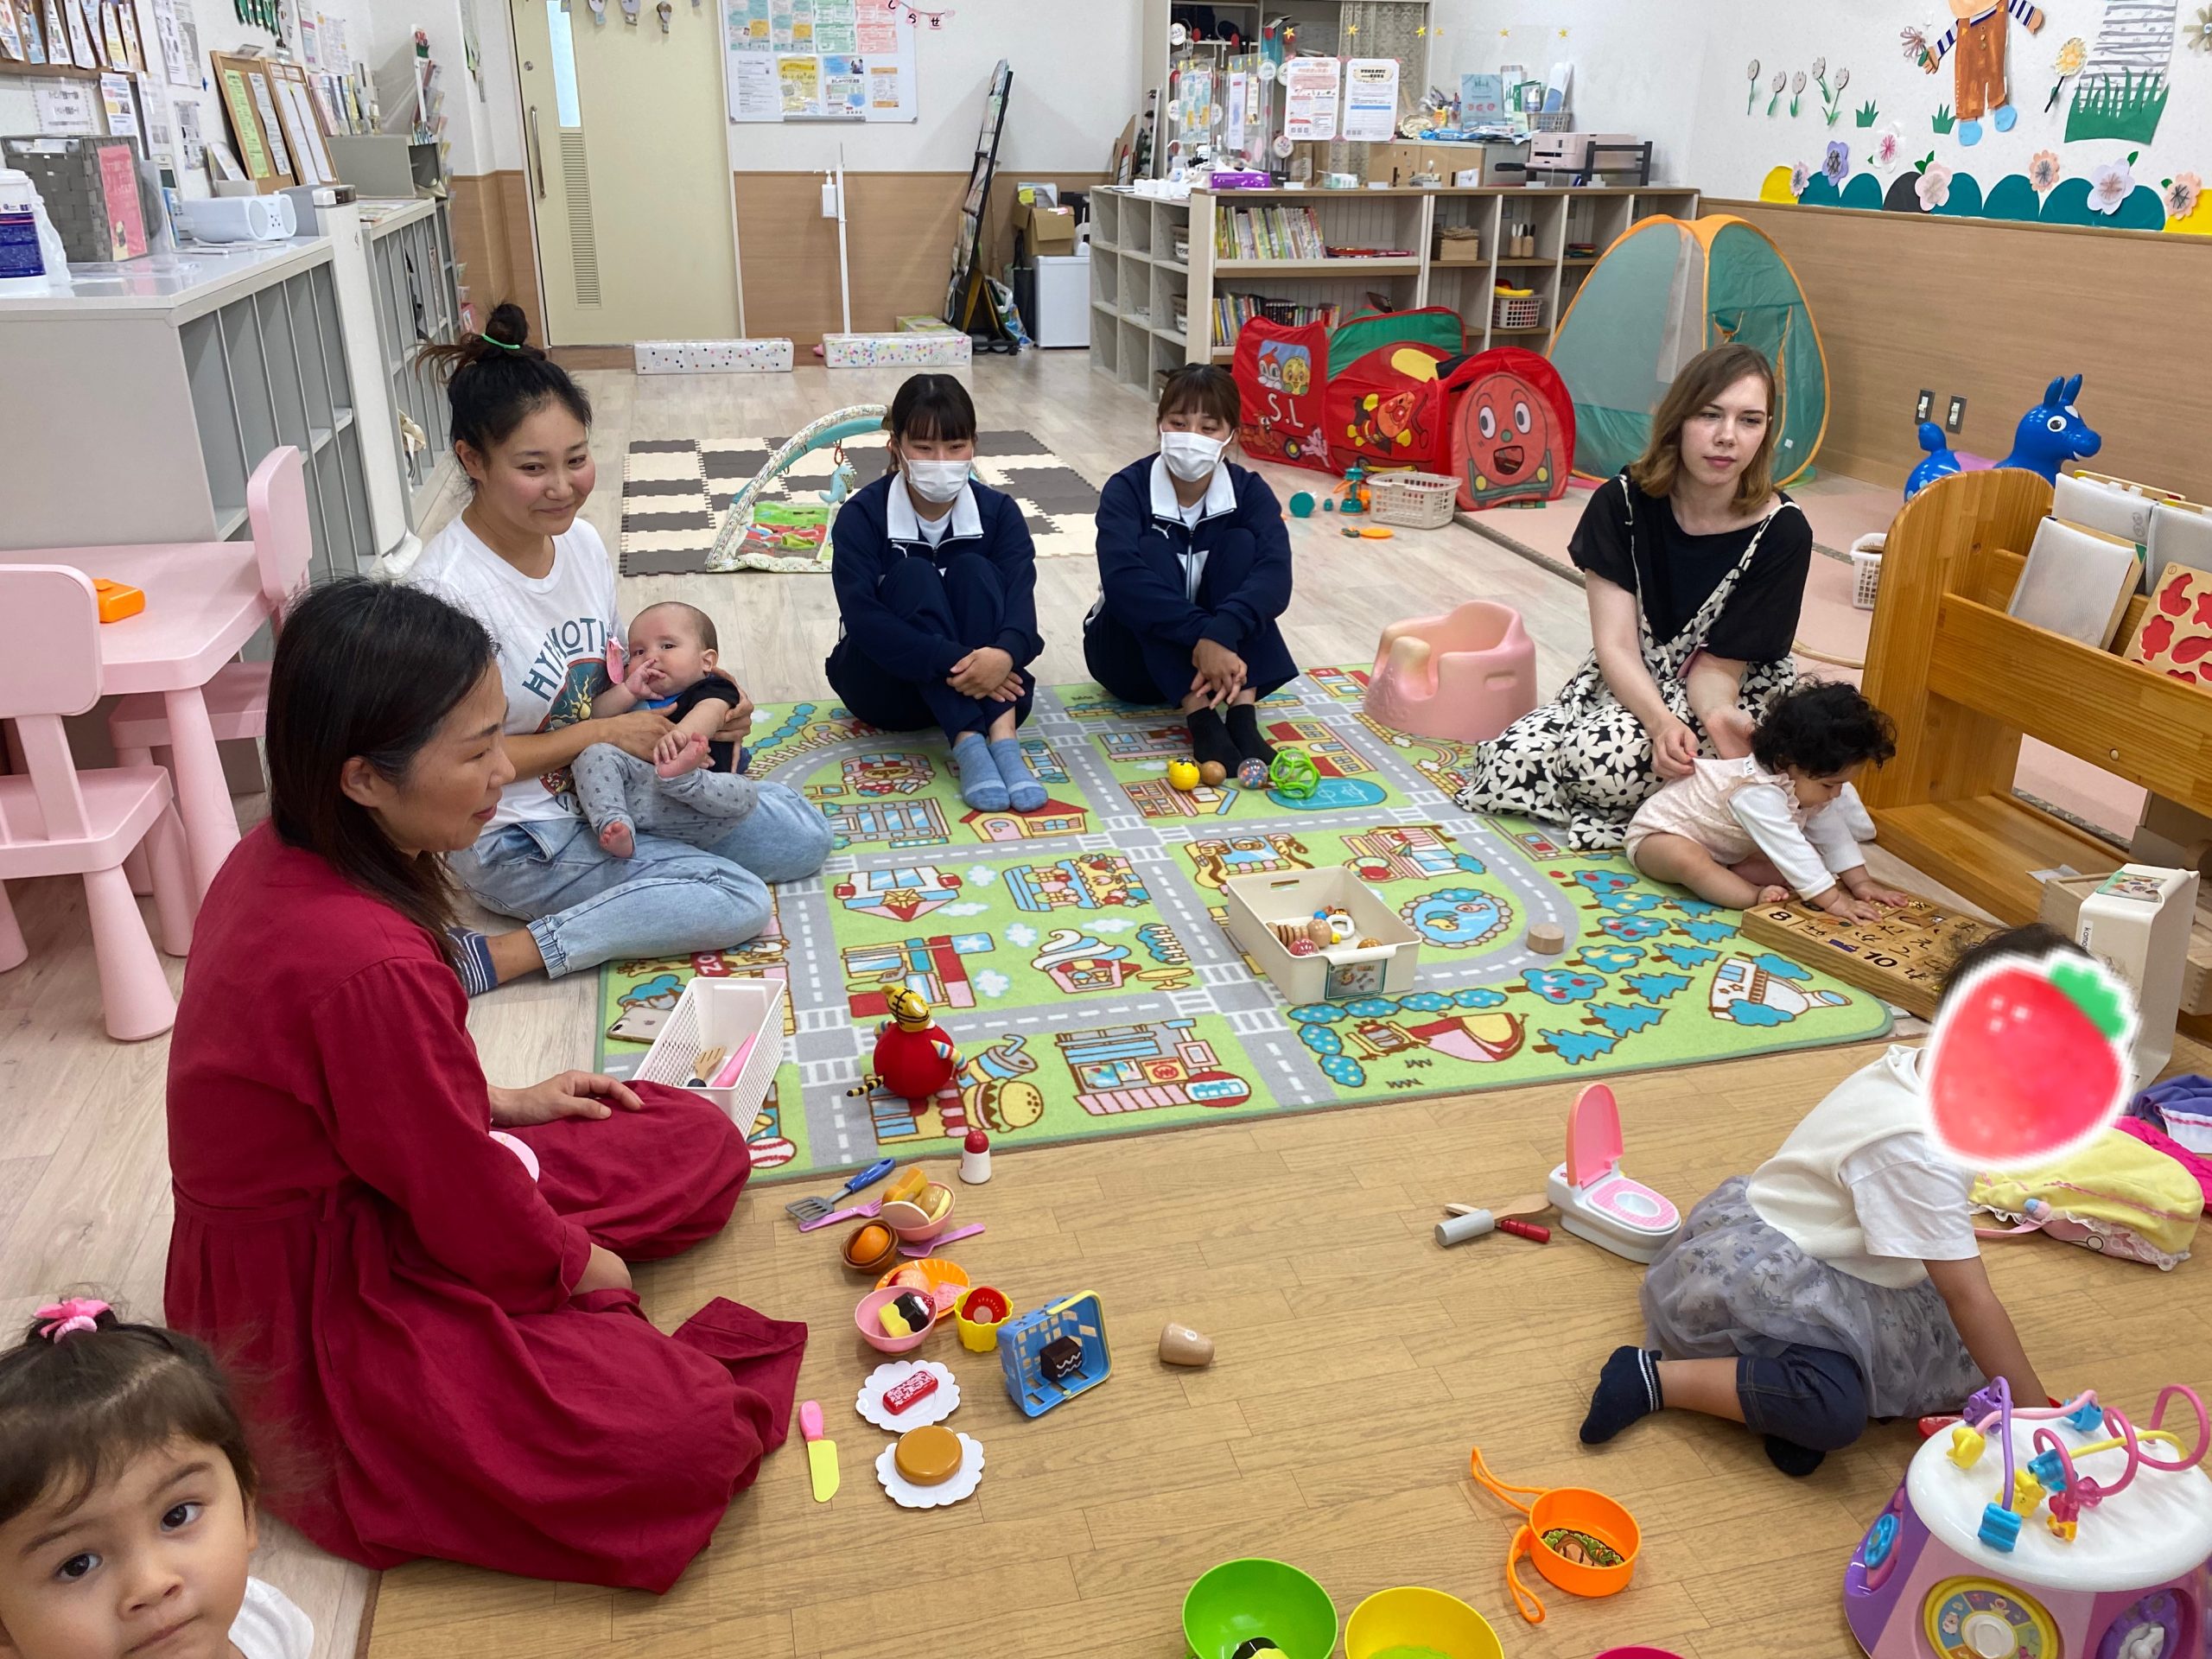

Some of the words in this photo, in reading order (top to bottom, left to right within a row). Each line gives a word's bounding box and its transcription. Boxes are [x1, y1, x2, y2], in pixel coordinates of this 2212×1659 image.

[1769, 911, 1792, 922] 8
[1798, 925, 1828, 938] は
[1876, 925, 1905, 936] た
[1854, 931, 1882, 943] か
[1864, 950, 1898, 968] 10
